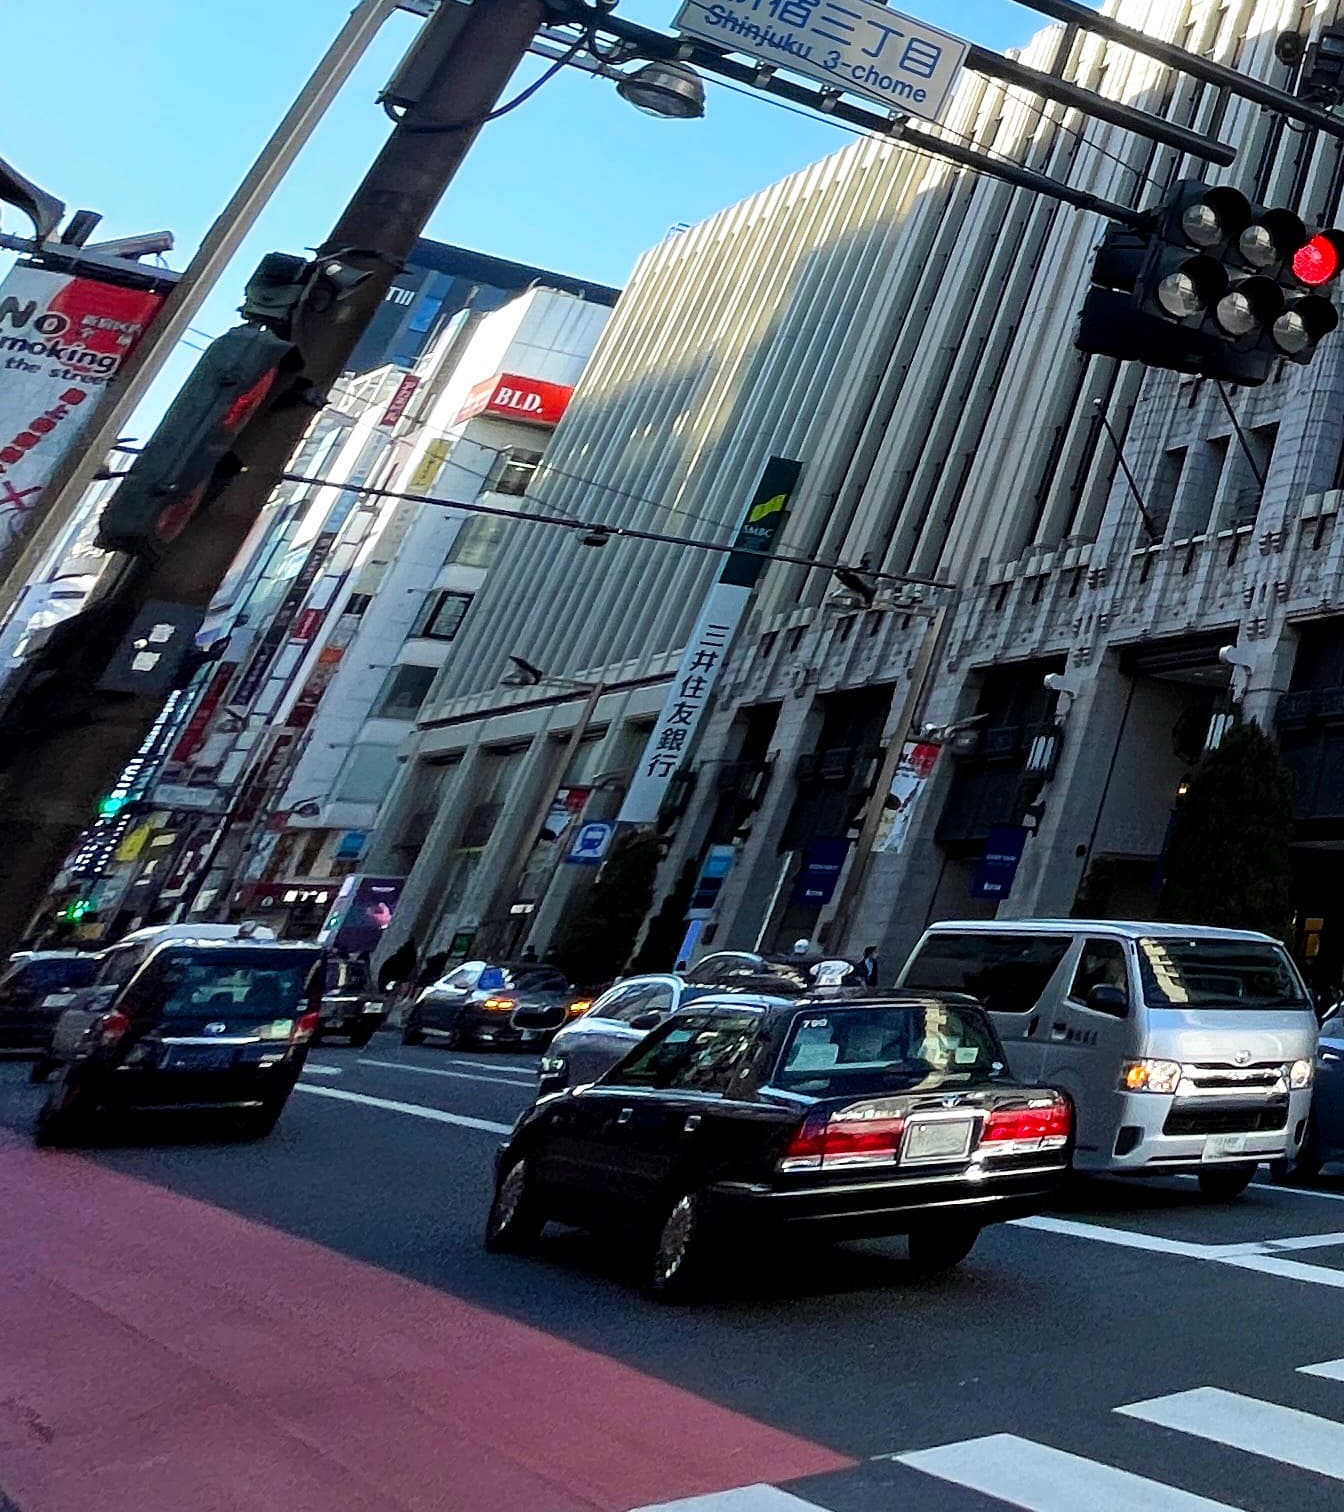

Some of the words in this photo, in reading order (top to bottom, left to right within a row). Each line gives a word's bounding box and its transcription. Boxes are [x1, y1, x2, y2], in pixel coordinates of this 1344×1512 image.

[704, 3, 814, 59] Shinjuku
[821, 49, 928, 104] 3-chome
[0, 331, 118, 375] moking
[5, 355, 41, 374] the
[493, 386, 544, 415] BLD.
[646, 623, 731, 779] 三井住友銀行
